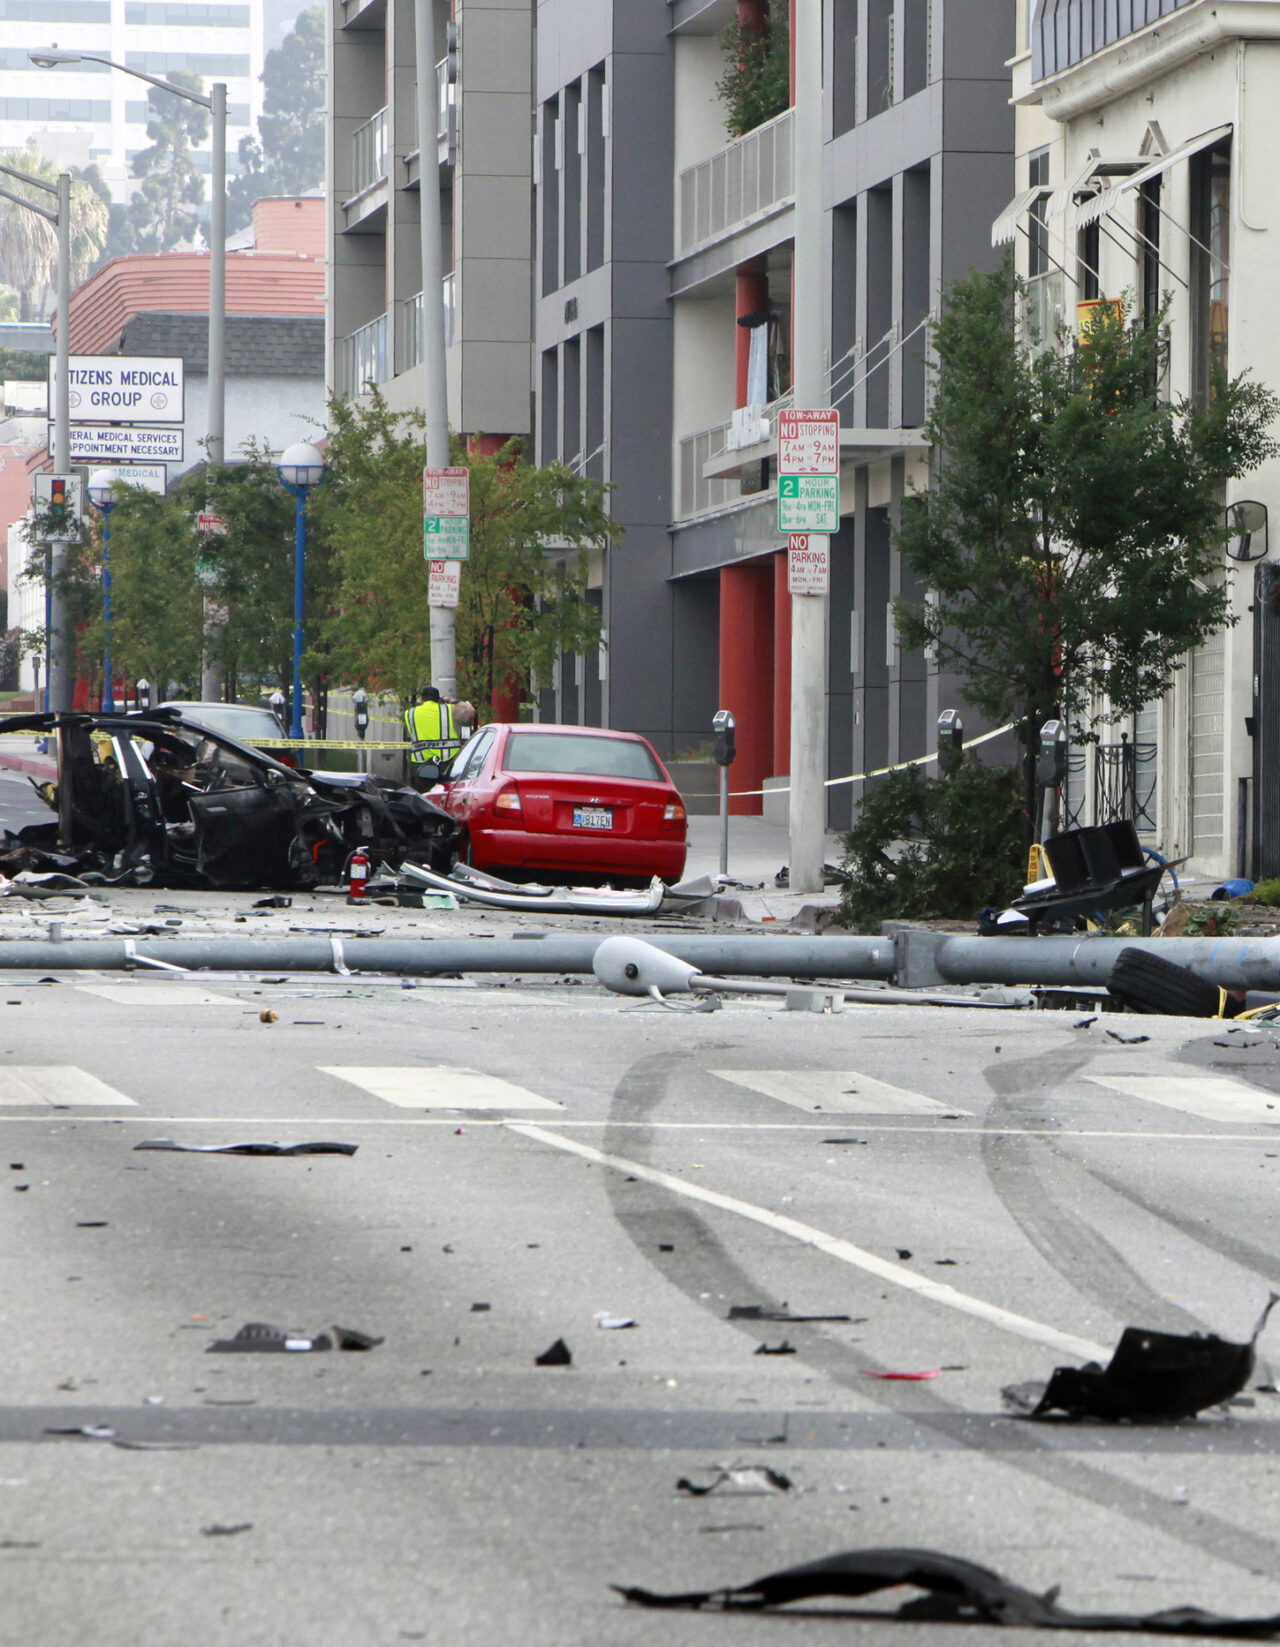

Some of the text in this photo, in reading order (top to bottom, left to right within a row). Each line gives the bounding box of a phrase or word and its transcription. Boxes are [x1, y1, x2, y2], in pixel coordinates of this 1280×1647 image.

[54, 370, 178, 386] TIZENS MEDICAL
[91, 391, 142, 406] GROUP
[784, 411, 832, 420] TOW-AWAY
[781, 423, 835, 438] NO STOPPING
[69, 431, 177, 443] ERAL MEDICAL SERVICES
[131, 445, 179, 455] NECESSARY
[783, 480, 794, 495] 2
[800, 488, 834, 499] PARKING
[428, 520, 436, 532] 2
[790, 536, 807, 549] NO
[791, 552, 826, 563] PARKING
[431, 561, 443, 572] NO
[431, 574, 457, 584] PARKING
